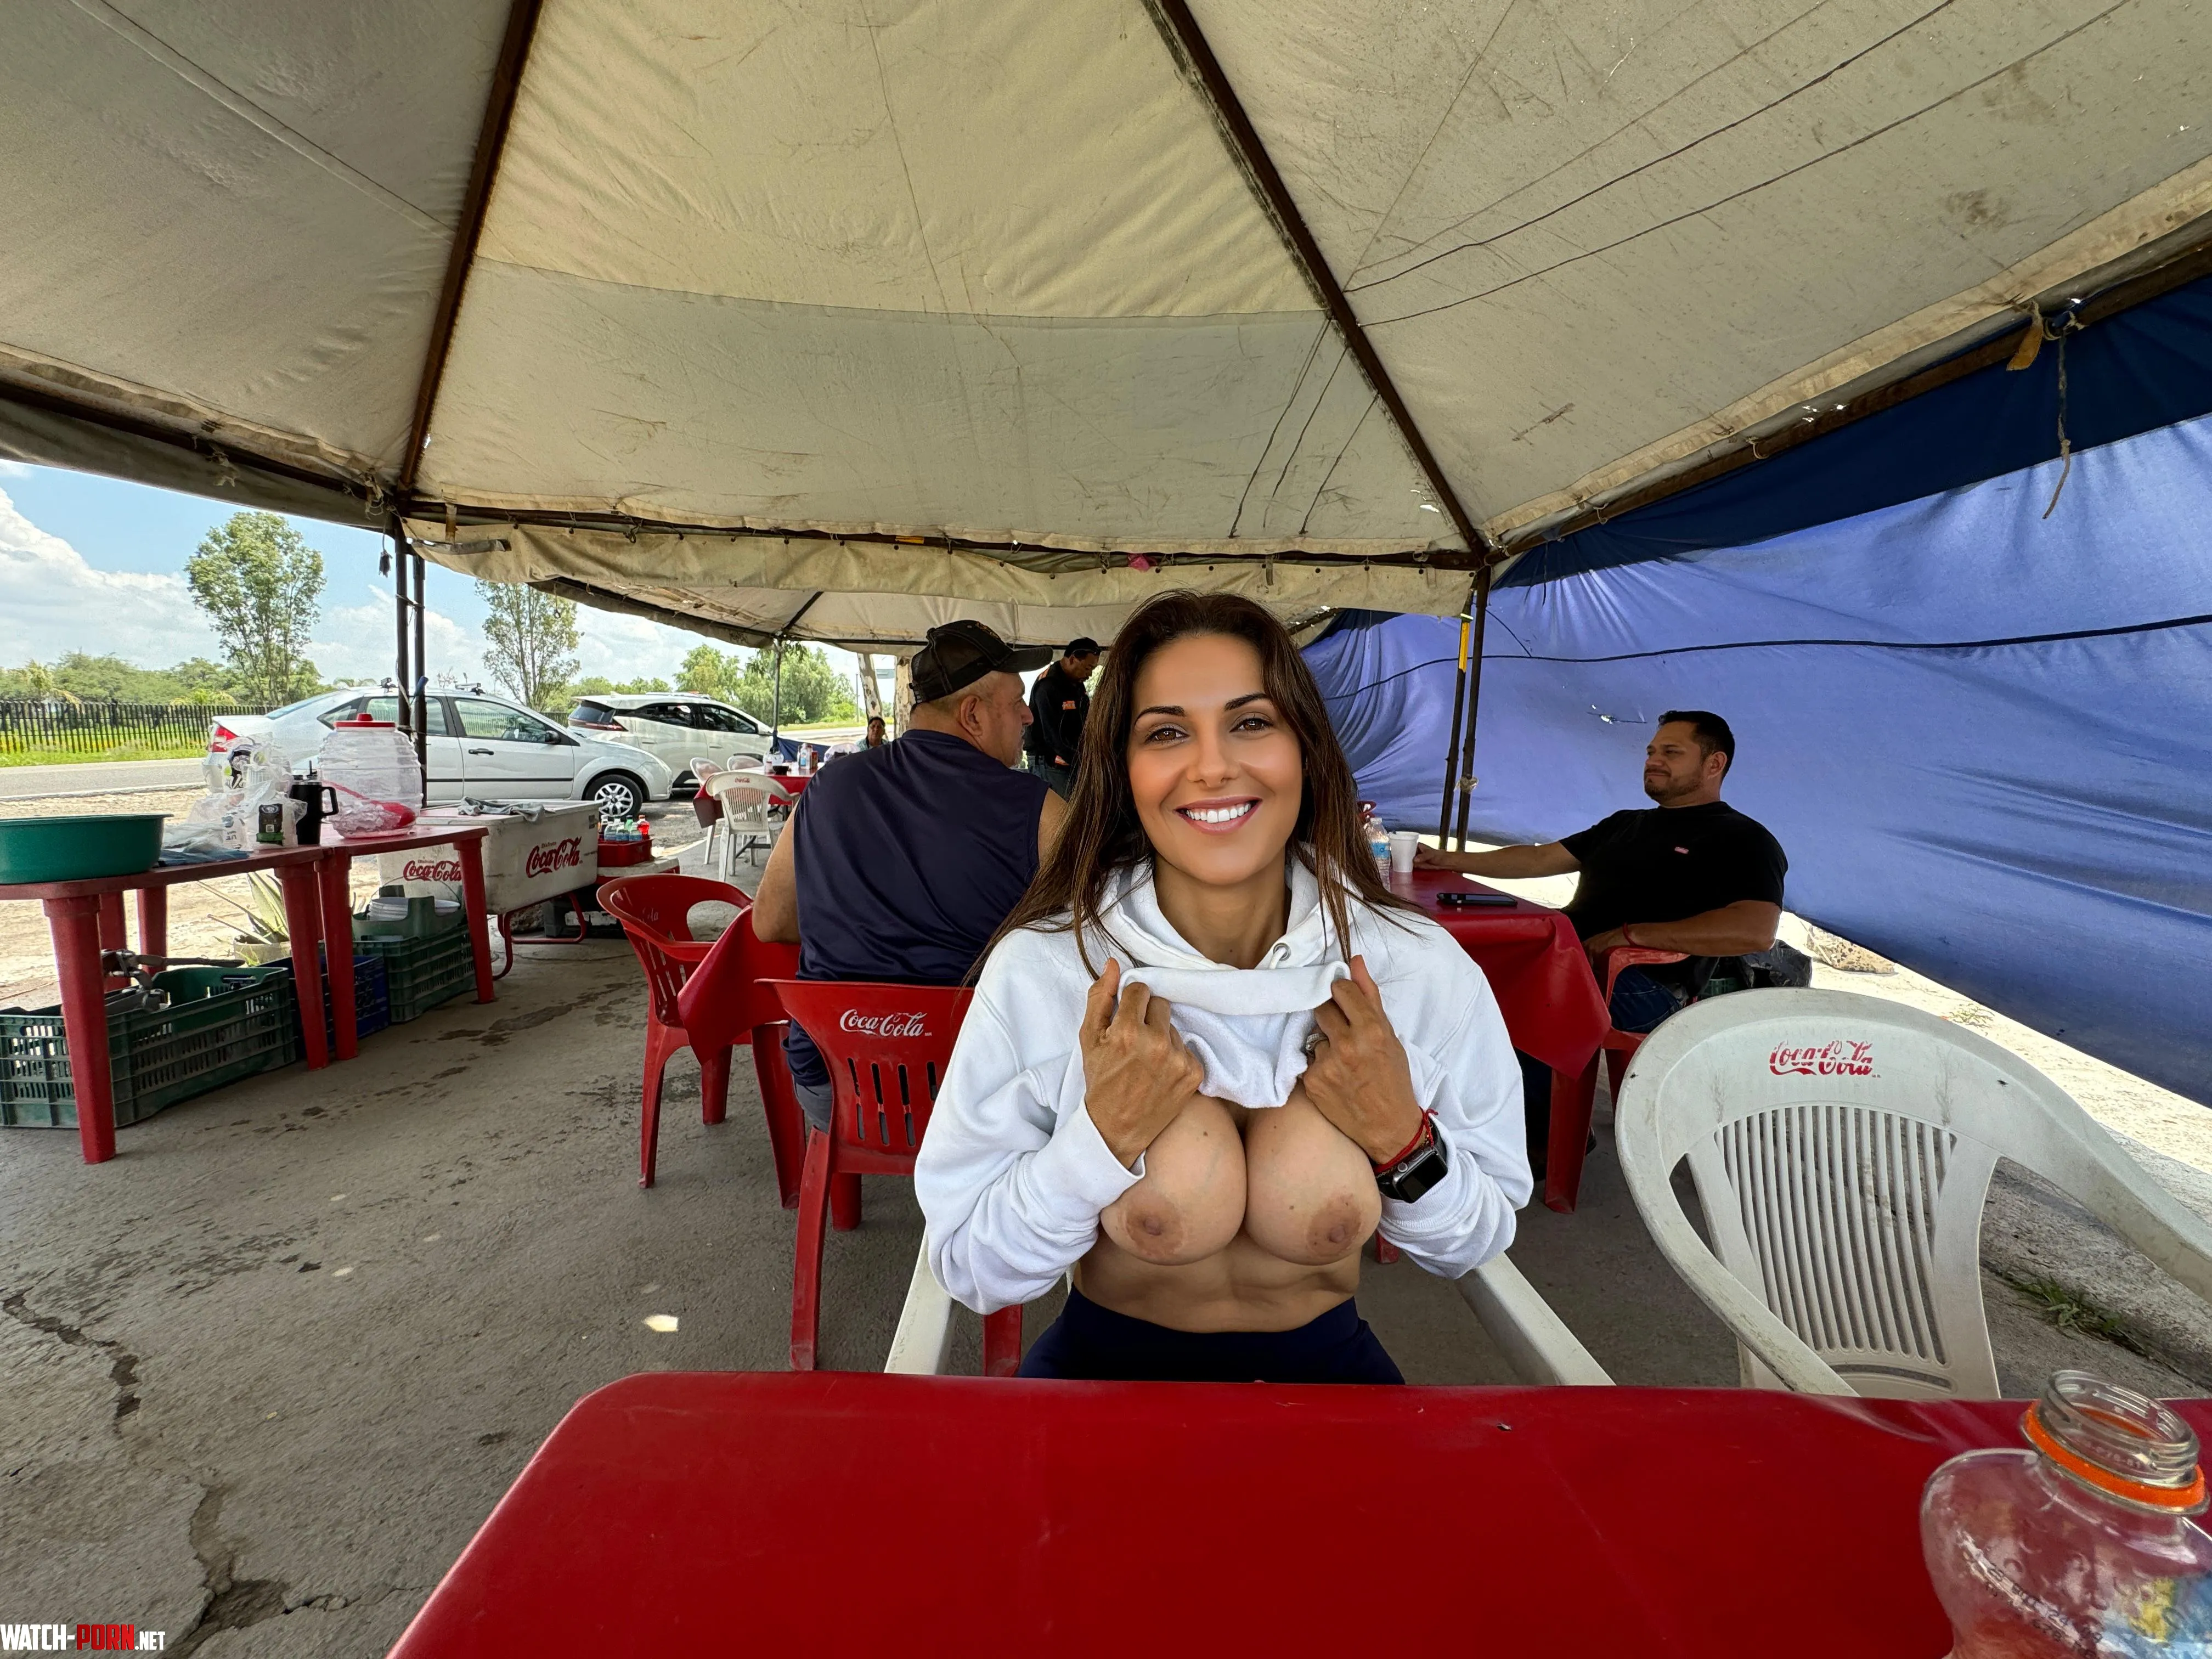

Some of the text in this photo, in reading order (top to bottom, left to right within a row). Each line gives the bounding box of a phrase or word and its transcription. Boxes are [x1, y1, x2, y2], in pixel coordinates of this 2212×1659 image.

[403, 860, 462, 881] Coca-Cola
[526, 836, 582, 878] Coca-Cola
[839, 1009, 928, 1036] Coca-Cola
[1769, 1040, 1873, 1075] Coca-Cola
